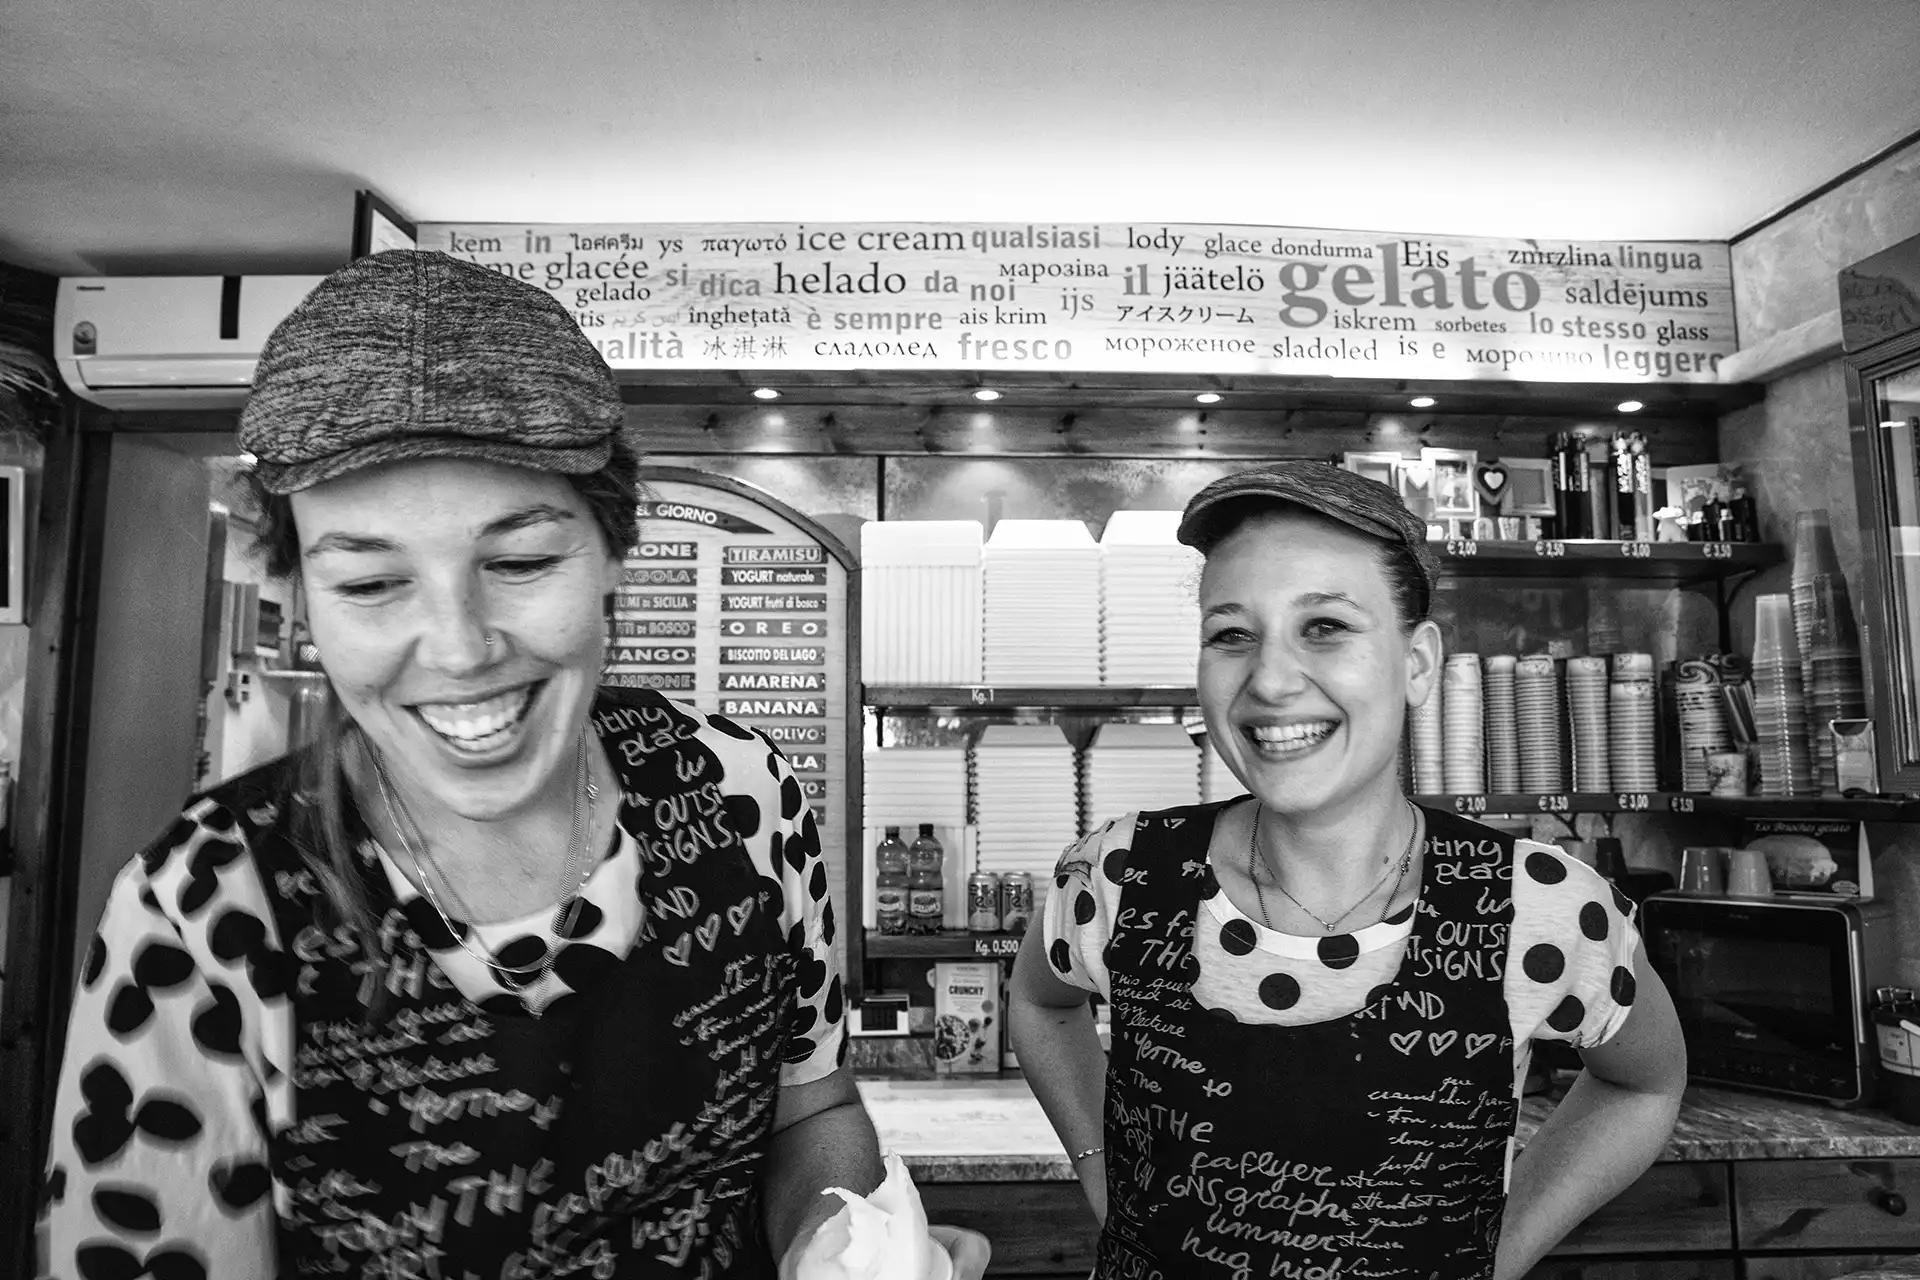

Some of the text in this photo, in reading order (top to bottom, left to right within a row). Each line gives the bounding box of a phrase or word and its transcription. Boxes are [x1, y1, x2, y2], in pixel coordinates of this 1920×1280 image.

[450, 231, 501, 252] kem
[525, 230, 551, 253] in
[659, 239, 683, 259] ys
[701, 235, 787, 256] παγωτό
[797, 226, 965, 251] ice cream
[971, 225, 1100, 252] qualsiasi
[1127, 227, 1185, 257] lody
[1205, 233, 1262, 259] glace
[1271, 238, 1373, 260] dondurma
[1402, 240, 1450, 269] Eis
[1508, 245, 1613, 268] zmrzlina
[1618, 245, 1703, 273] lingua
[545, 252, 649, 289] glacée
[665, 264, 761, 297] si dica
[774, 262, 906, 294] helado
[1000, 259, 1109, 283] марозіва
[1122, 264, 1151, 296] il
[1163, 265, 1265, 298] jäätelö
[575, 282, 651, 307] gelado
[924, 270, 1016, 301] da noi
[1278, 242, 1541, 328] gelato
[1564, 279, 1708, 314] saldējums
[959, 306, 1047, 325] ais krim
[1060, 288, 1094, 320] ijs
[1117, 305, 1255, 324] アイスクリーム
[568, 310, 605, 328] tis
[807, 307, 942, 334] è sempre
[1333, 309, 1416, 331] iskrem
[1434, 317, 1506, 333] sorbetes
[1530, 312, 1646, 339] lo stesso
[1657, 319, 1709, 346] glass
[957, 333, 1072, 360] fresco
[1105, 337, 1256, 357] мороженое
[1273, 337, 1377, 360] sladoled
[1400, 336, 1418, 356] is
[656, 504, 717, 524] GIORNO
[732, 548, 818, 561] TIRAMISU
[731, 570, 774, 583] YOGURT
[728, 596, 763, 609] YOGURT
[772, 649, 788, 661] DEL
[790, 649, 817, 661] LAGO
[725, 675, 819, 689] AMARENA
[725, 701, 819, 715] BANANA
[766, 728, 819, 741] OLIVO
[1202, 1078, 1232, 1097] to
